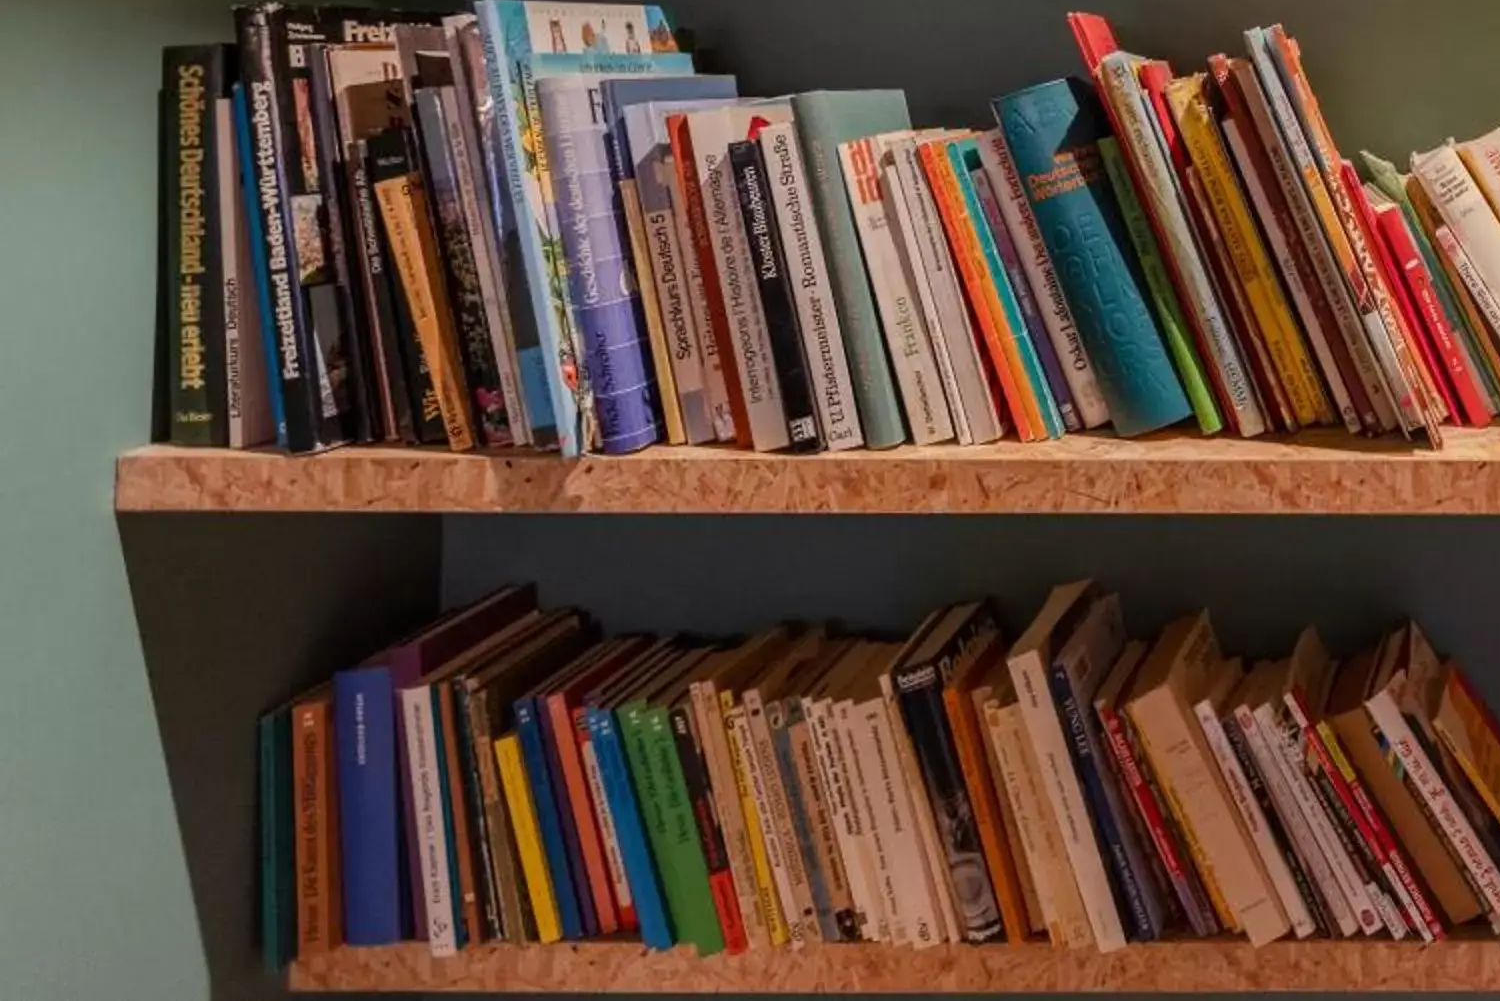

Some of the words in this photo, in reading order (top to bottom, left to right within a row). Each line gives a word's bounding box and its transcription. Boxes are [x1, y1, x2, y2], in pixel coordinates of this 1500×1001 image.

[179, 64, 204, 145] Schönes
[251, 80, 291, 270] Baden-Württemberg
[561, 149, 583, 211] deutschen
[770, 132, 796, 187] Straße
[987, 134, 1025, 202] Fortschritt
[180, 148, 205, 273] Deutschland
[571, 211, 589, 235] der
[650, 213, 665, 224] 5
[739, 164, 768, 234] Blaubeuren
[1011, 198, 1040, 243] andere
[652, 225, 677, 283] Deutsch
[717, 235, 735, 255] de
[754, 231, 777, 279] Kloster
[782, 185, 817, 289] Romantische
[180, 284, 201, 322] neu
[575, 237, 599, 304] Geschichte
[1036, 264, 1074, 333] Lafontaine
[1456, 260, 1482, 292] There
[221, 277, 237, 330] Deutsch
[273, 272, 301, 379] Freizeitland
[663, 282, 694, 360] Sprachkurs
[180, 324, 205, 387] erlebt
[225, 337, 243, 418] Literaturkurs
[733, 315, 764, 405] Interrogeons
[804, 294, 842, 410] Pfistermeister
[1060, 330, 1088, 373] Oskar
